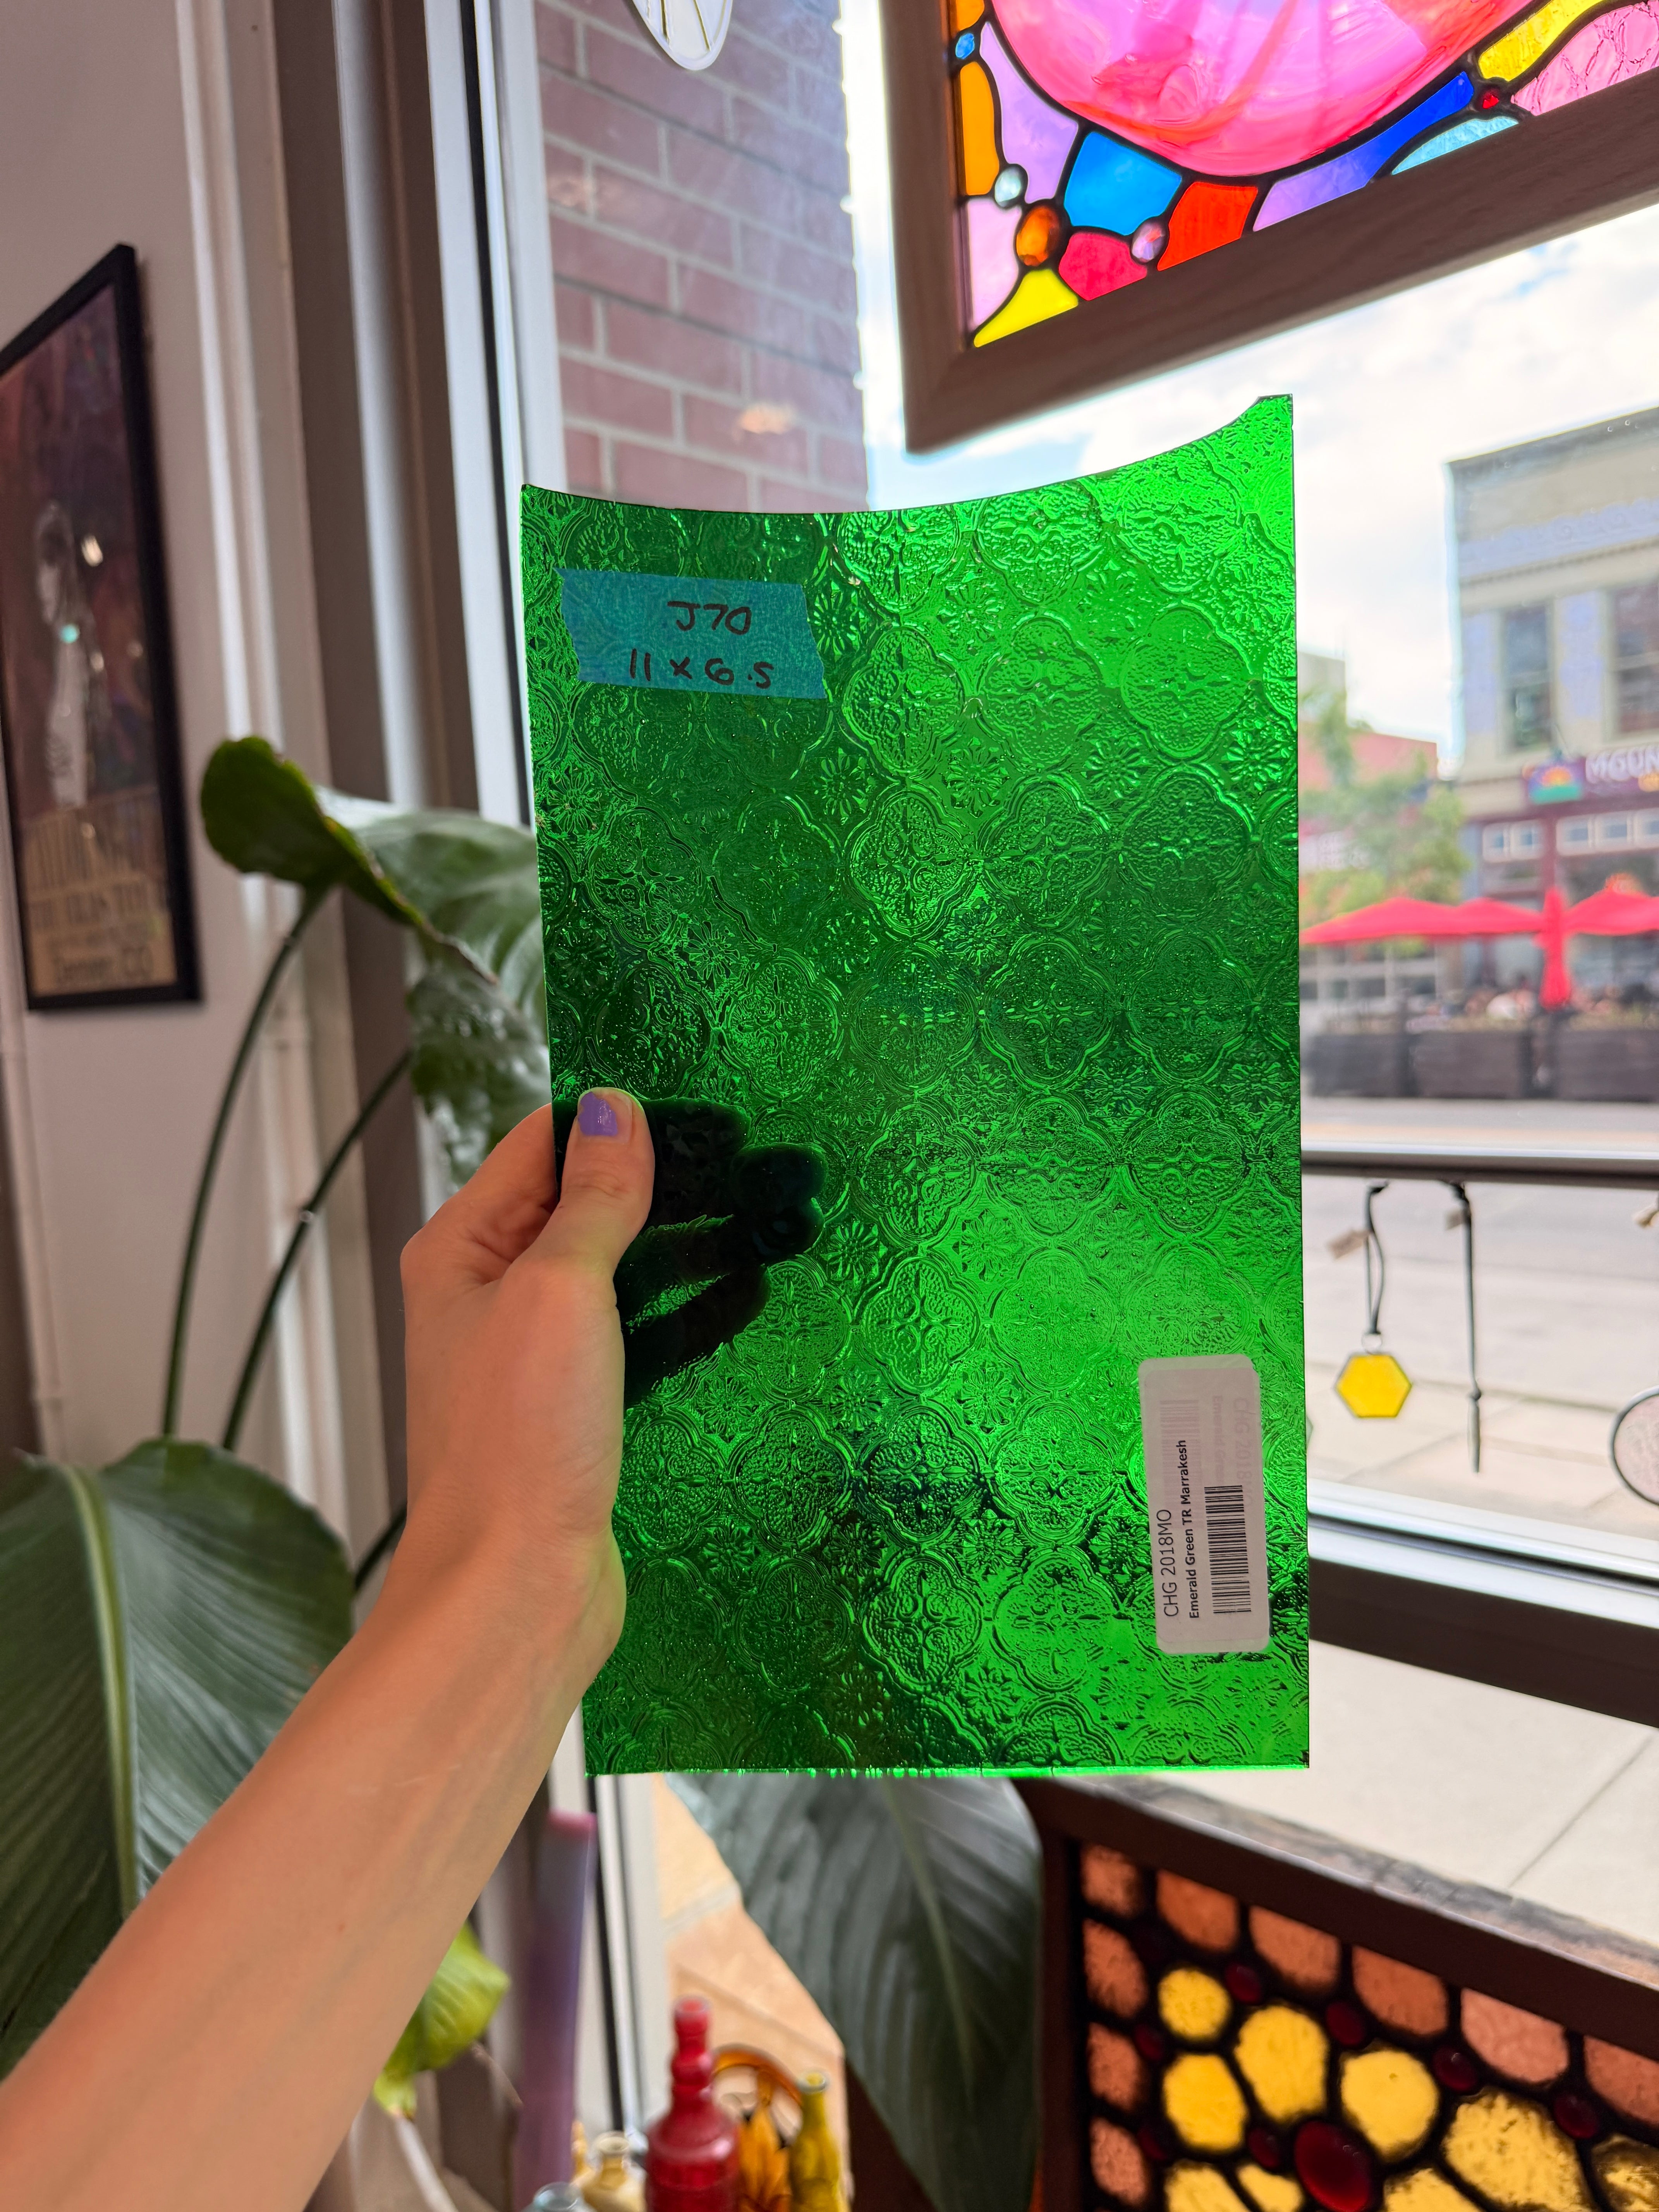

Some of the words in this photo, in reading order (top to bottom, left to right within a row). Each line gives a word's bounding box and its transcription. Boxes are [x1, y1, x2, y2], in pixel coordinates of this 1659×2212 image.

[667, 601, 751, 635] J70
[630, 648, 651, 681] 11
[704, 658, 774, 689] 6.5
[1176, 1440, 1191, 1504] Marrakesh
[1181, 1508, 1192, 1526] TR
[1156, 1510, 1176, 1576] 2018MO
[1185, 1529, 1195, 1565] Green
[1162, 1582, 1179, 1617] CHG
[1185, 1569, 1199, 1618] Emerald
